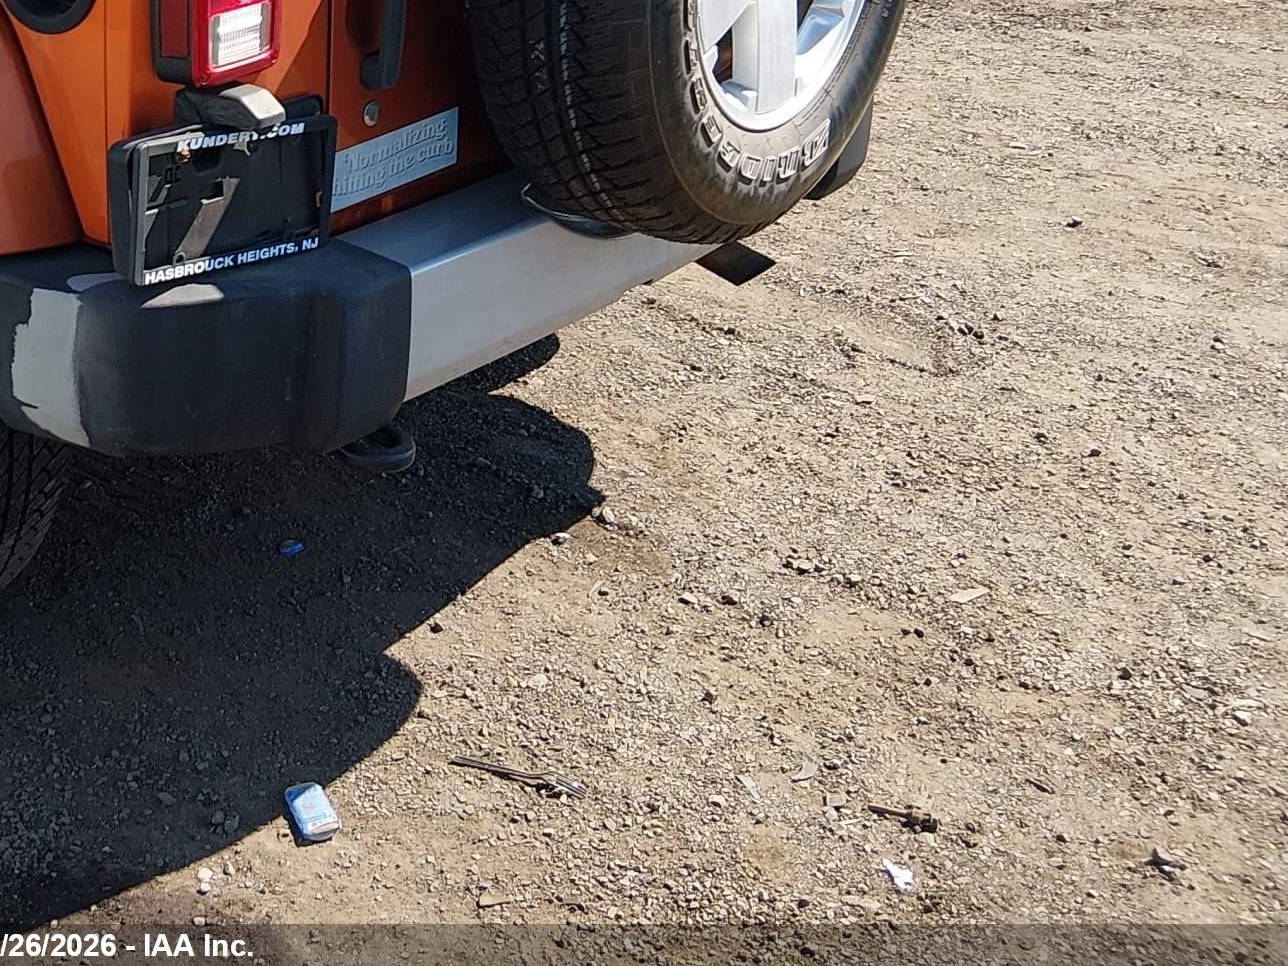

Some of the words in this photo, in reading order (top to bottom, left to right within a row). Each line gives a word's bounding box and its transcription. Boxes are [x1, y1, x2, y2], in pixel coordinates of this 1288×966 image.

[389, 153, 415, 177] the
[418, 138, 455, 163] curb
[144, 252, 234, 286] HASBROUCK
[237, 241, 300, 267] HEIGHTS,
[302, 237, 320, 251] NJ
